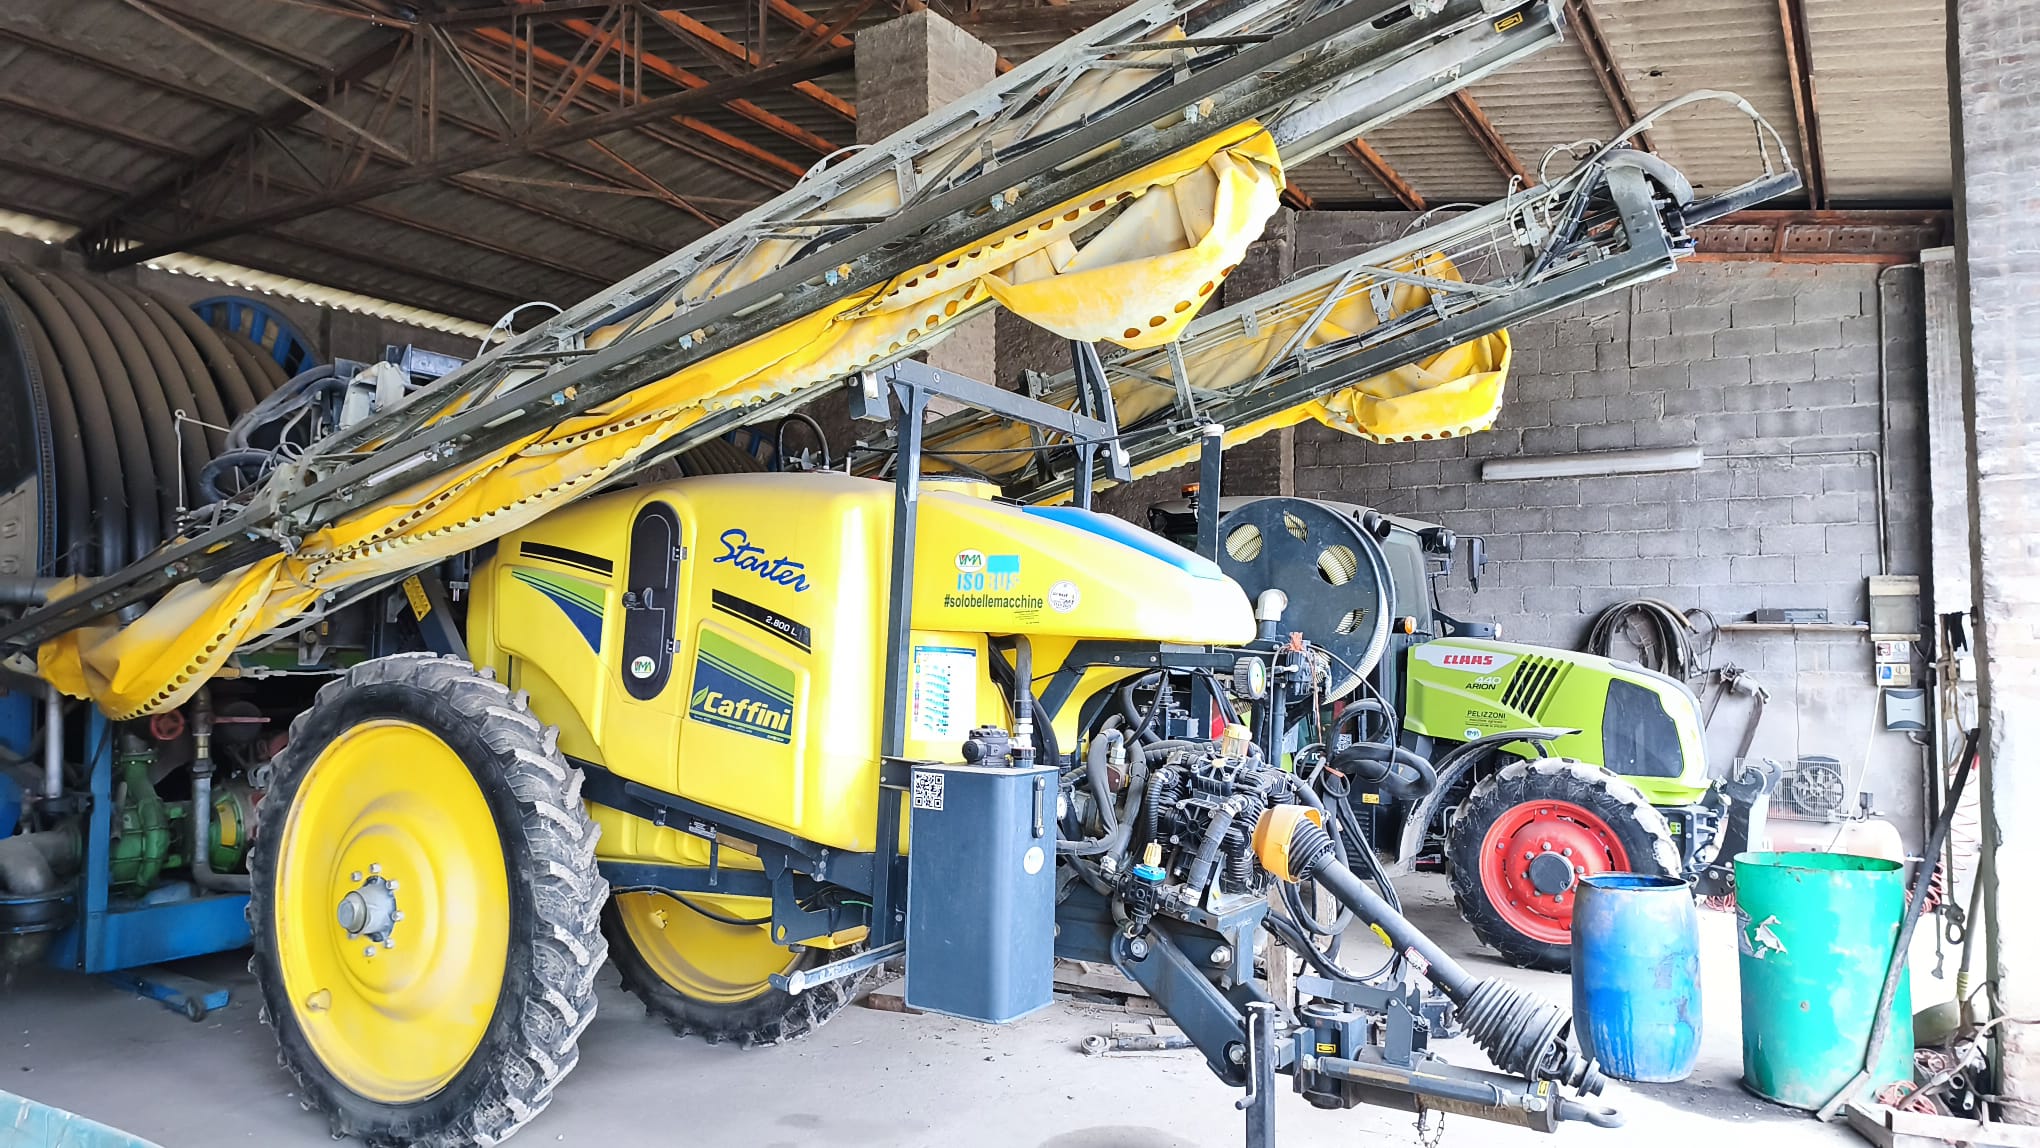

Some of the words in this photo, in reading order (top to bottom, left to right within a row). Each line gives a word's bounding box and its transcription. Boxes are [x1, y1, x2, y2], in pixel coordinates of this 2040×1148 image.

[713, 528, 810, 593] Starter
[944, 594, 1043, 609] #solobellemacchine
[765, 615, 791, 632] 2.800
[790, 627, 798, 637] L
[1443, 655, 1493, 665] CLAAS
[1475, 676, 1502, 684] 440
[703, 691, 791, 732] Caffini
[1467, 710, 1505, 718] PELIZZONI
